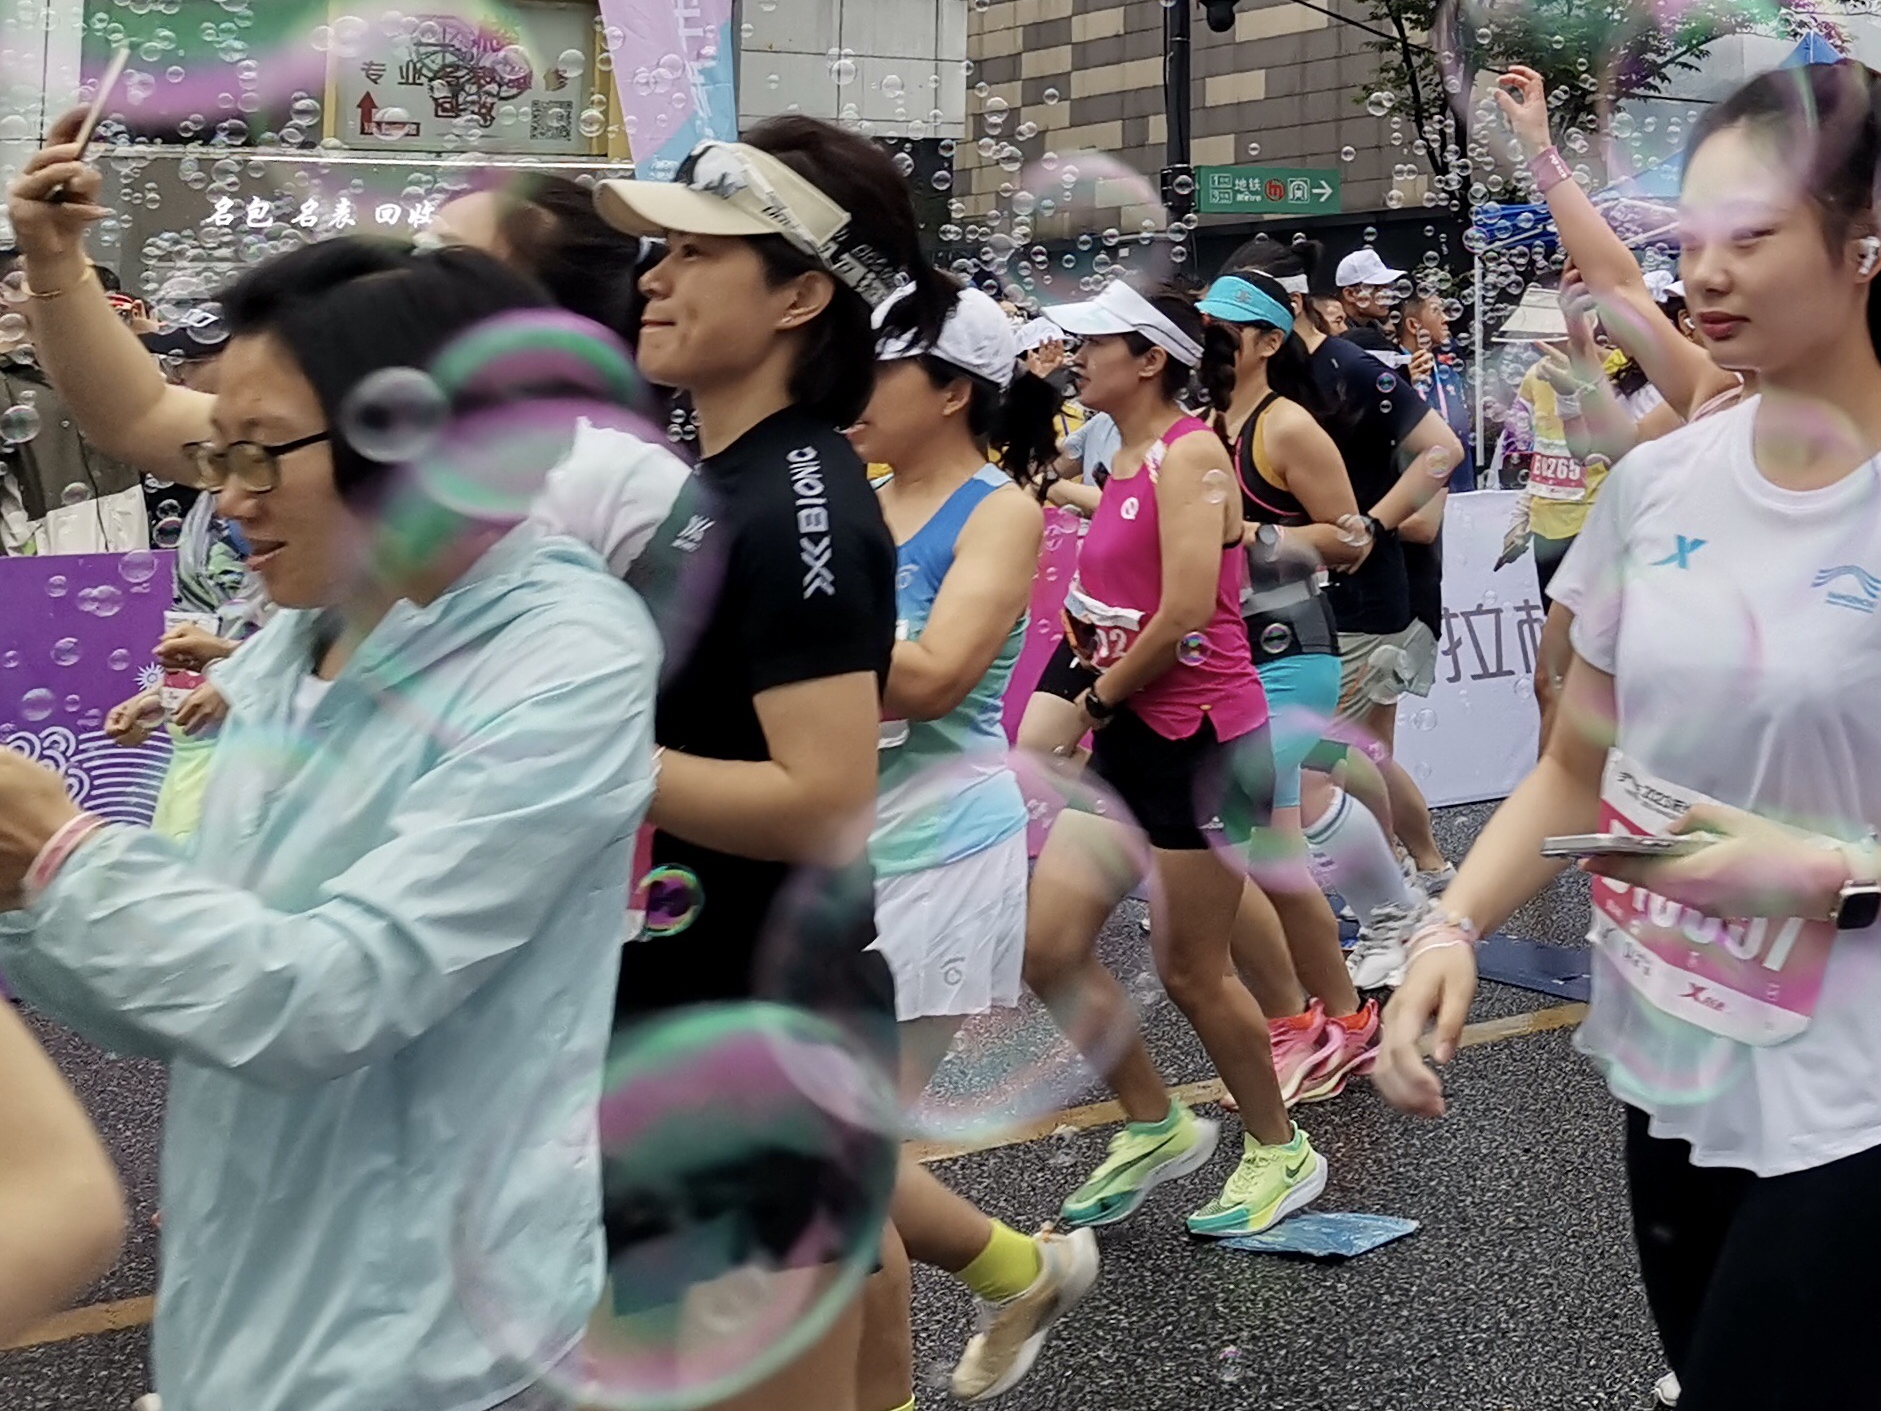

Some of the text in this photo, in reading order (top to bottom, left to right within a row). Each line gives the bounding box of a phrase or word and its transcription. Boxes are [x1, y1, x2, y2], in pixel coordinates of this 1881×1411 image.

[1233, 178, 1261, 191] 地铁
[202, 195, 437, 229] 名包 名表 回收
